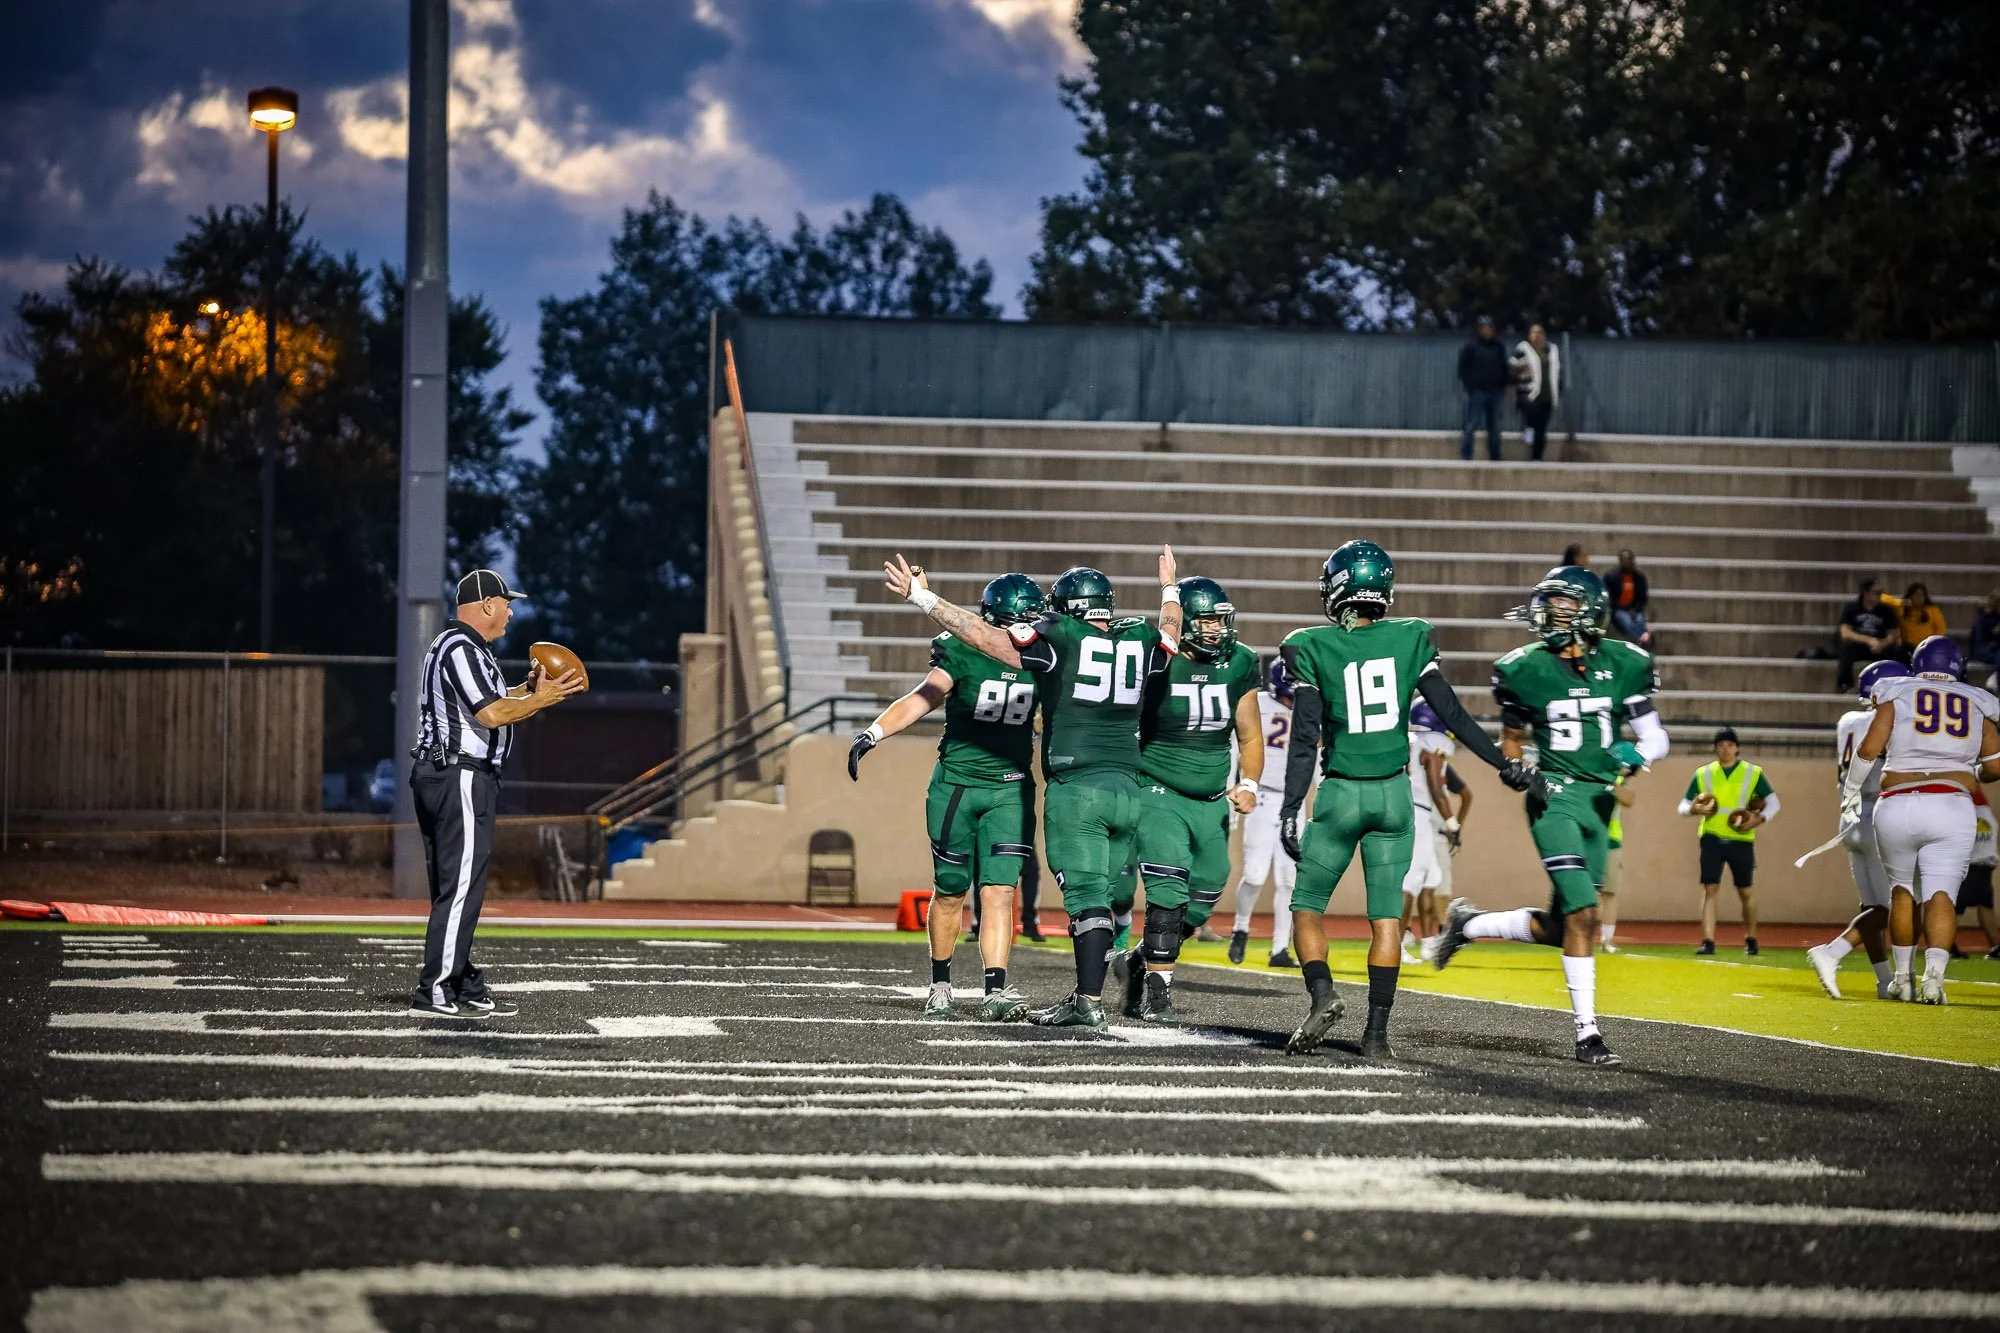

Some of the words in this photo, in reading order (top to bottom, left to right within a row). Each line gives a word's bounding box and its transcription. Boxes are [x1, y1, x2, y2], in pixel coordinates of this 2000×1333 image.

[1072, 636, 1144, 705] 50
[1343, 657, 1400, 734] 19
[974, 680, 1034, 725] 88
[1170, 684, 1231, 731] 70
[1914, 687, 1970, 739] 99
